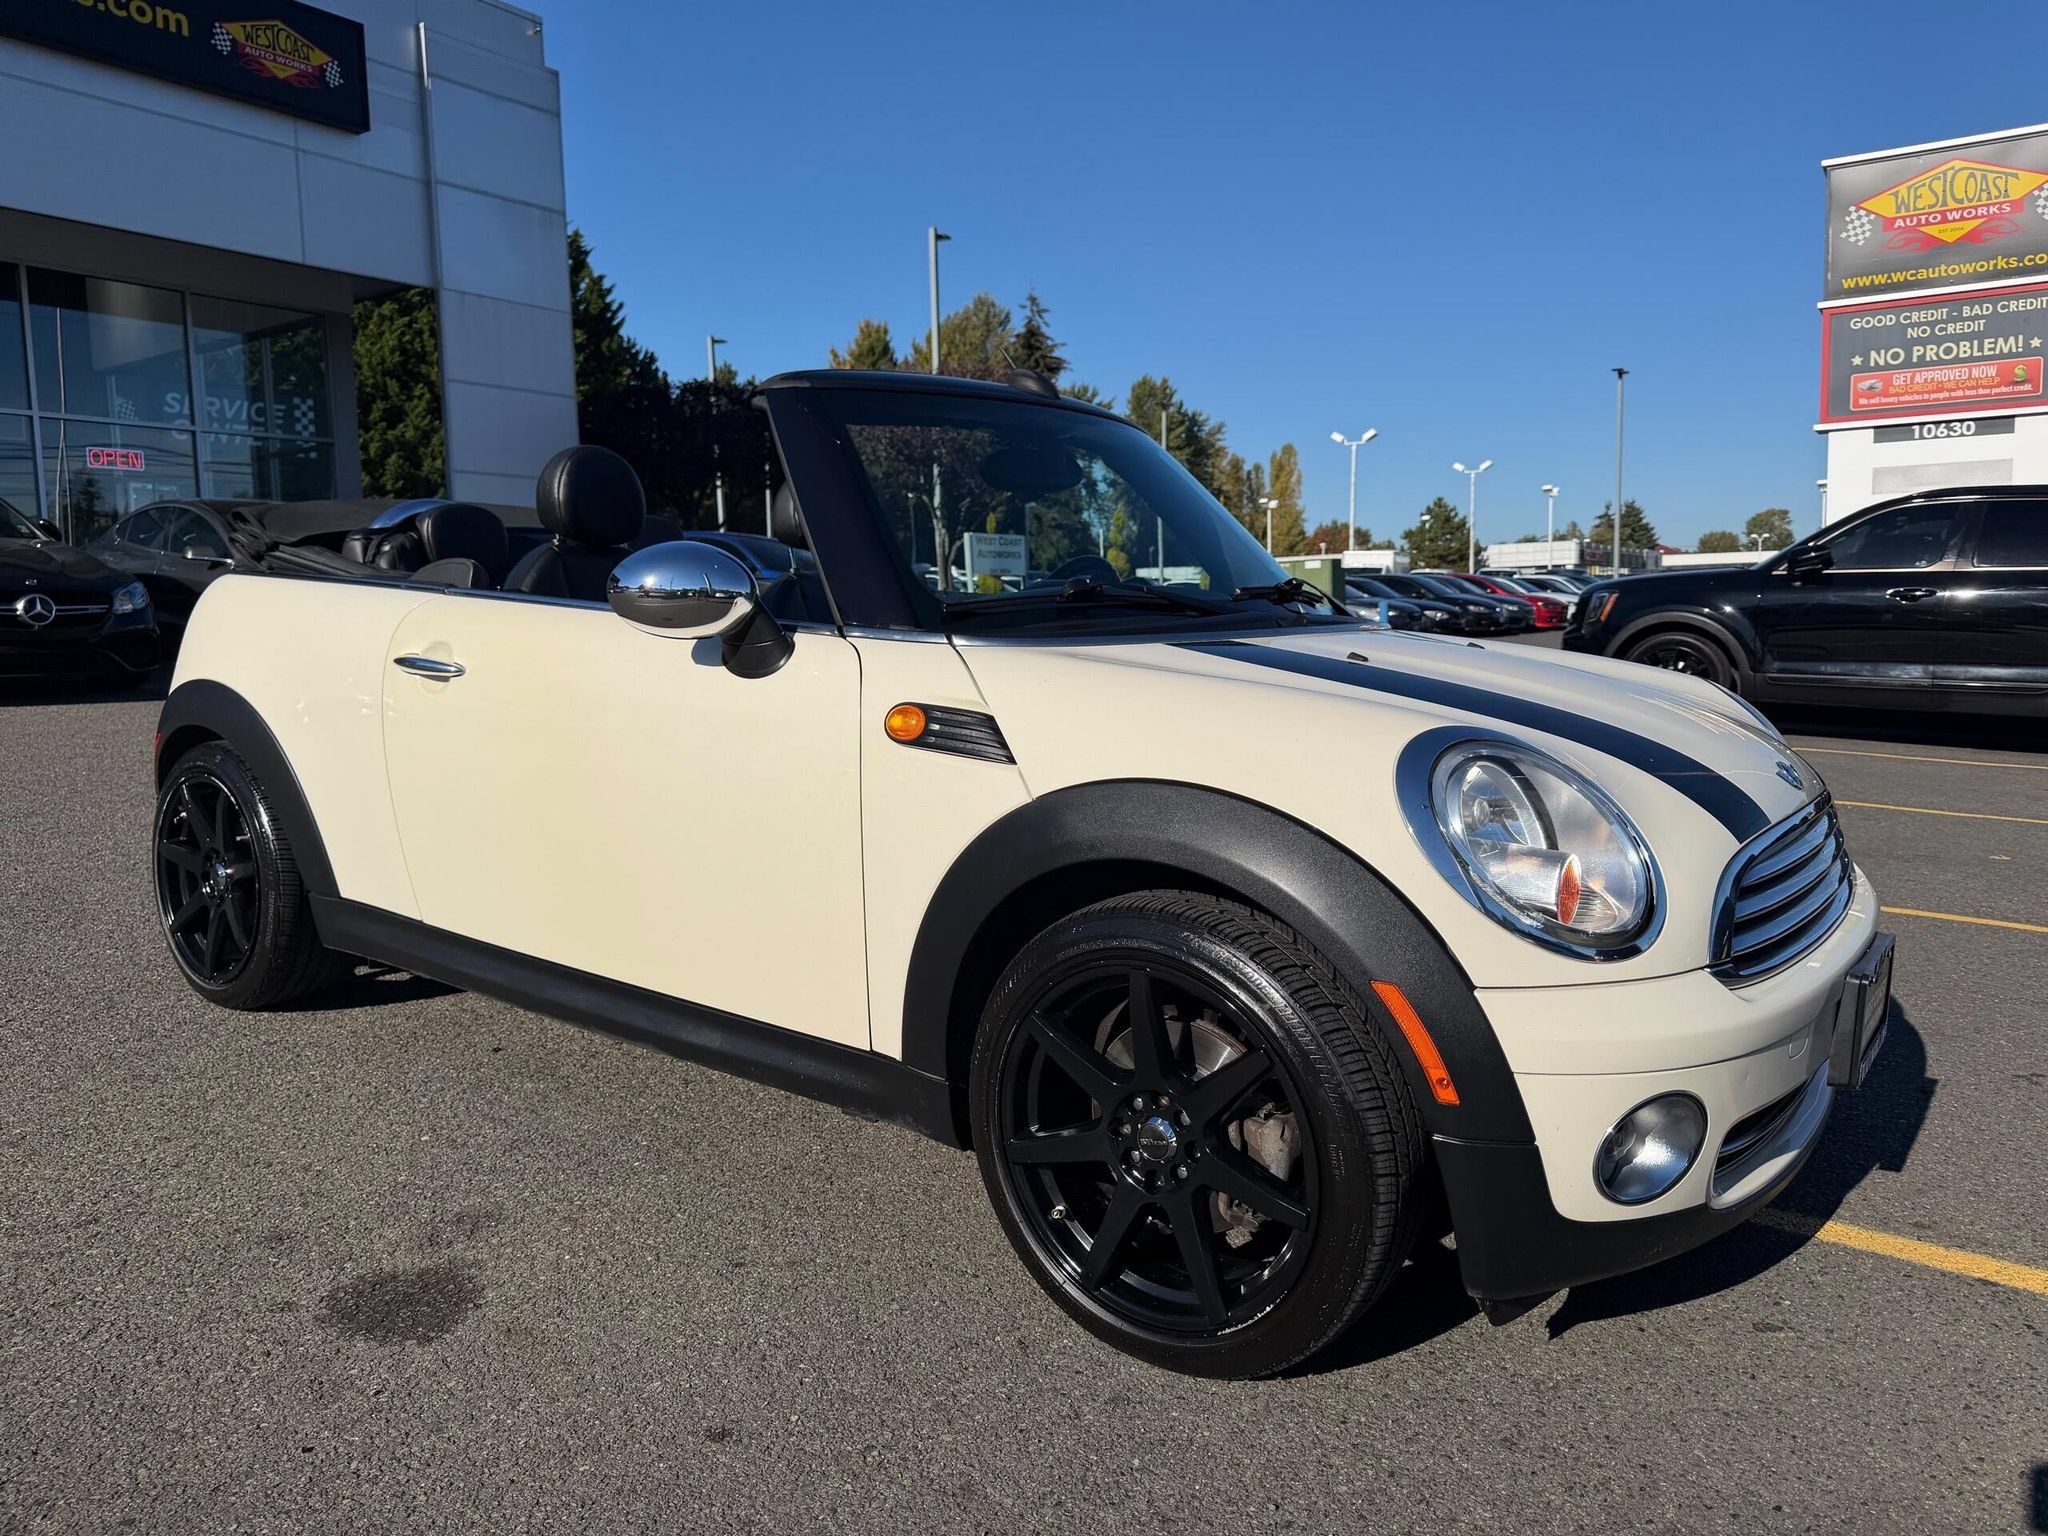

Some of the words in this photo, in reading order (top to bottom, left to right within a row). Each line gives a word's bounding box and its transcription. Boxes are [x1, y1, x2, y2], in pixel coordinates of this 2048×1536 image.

[78, 0, 189, 37] .com
[244, 46, 274, 60] AUTO
[275, 55, 313, 72] WORKS
[1894, 213, 1942, 229] AUTO
[1947, 203, 2012, 220] WORKS
[1850, 315, 1896, 330] GOOD
[1900, 308, 1949, 324] CREDIT
[1962, 303, 1993, 318] BAD
[1997, 297, 2048, 314] CREDIT
[1907, 326, 1931, 339] NO
[1935, 320, 1986, 335] CREDIT
[1870, 347, 1905, 367] NO
[1912, 334, 2024, 363] PROBLEM!
[1889, 385, 1907, 394] BAD
[1908, 382, 1938, 392] CREDIT
[1943, 381, 1957, 389] WE
[1958, 379, 1977, 388] CAN
[1978, 376, 2001, 386] HELP
[1893, 373, 1913, 386] GET
[1914, 368, 1969, 384] APPROVED
[1972, 365, 1997, 379] NOW
[1912, 421, 1976, 439] 10630
[90, 449, 141, 469] OPEN
